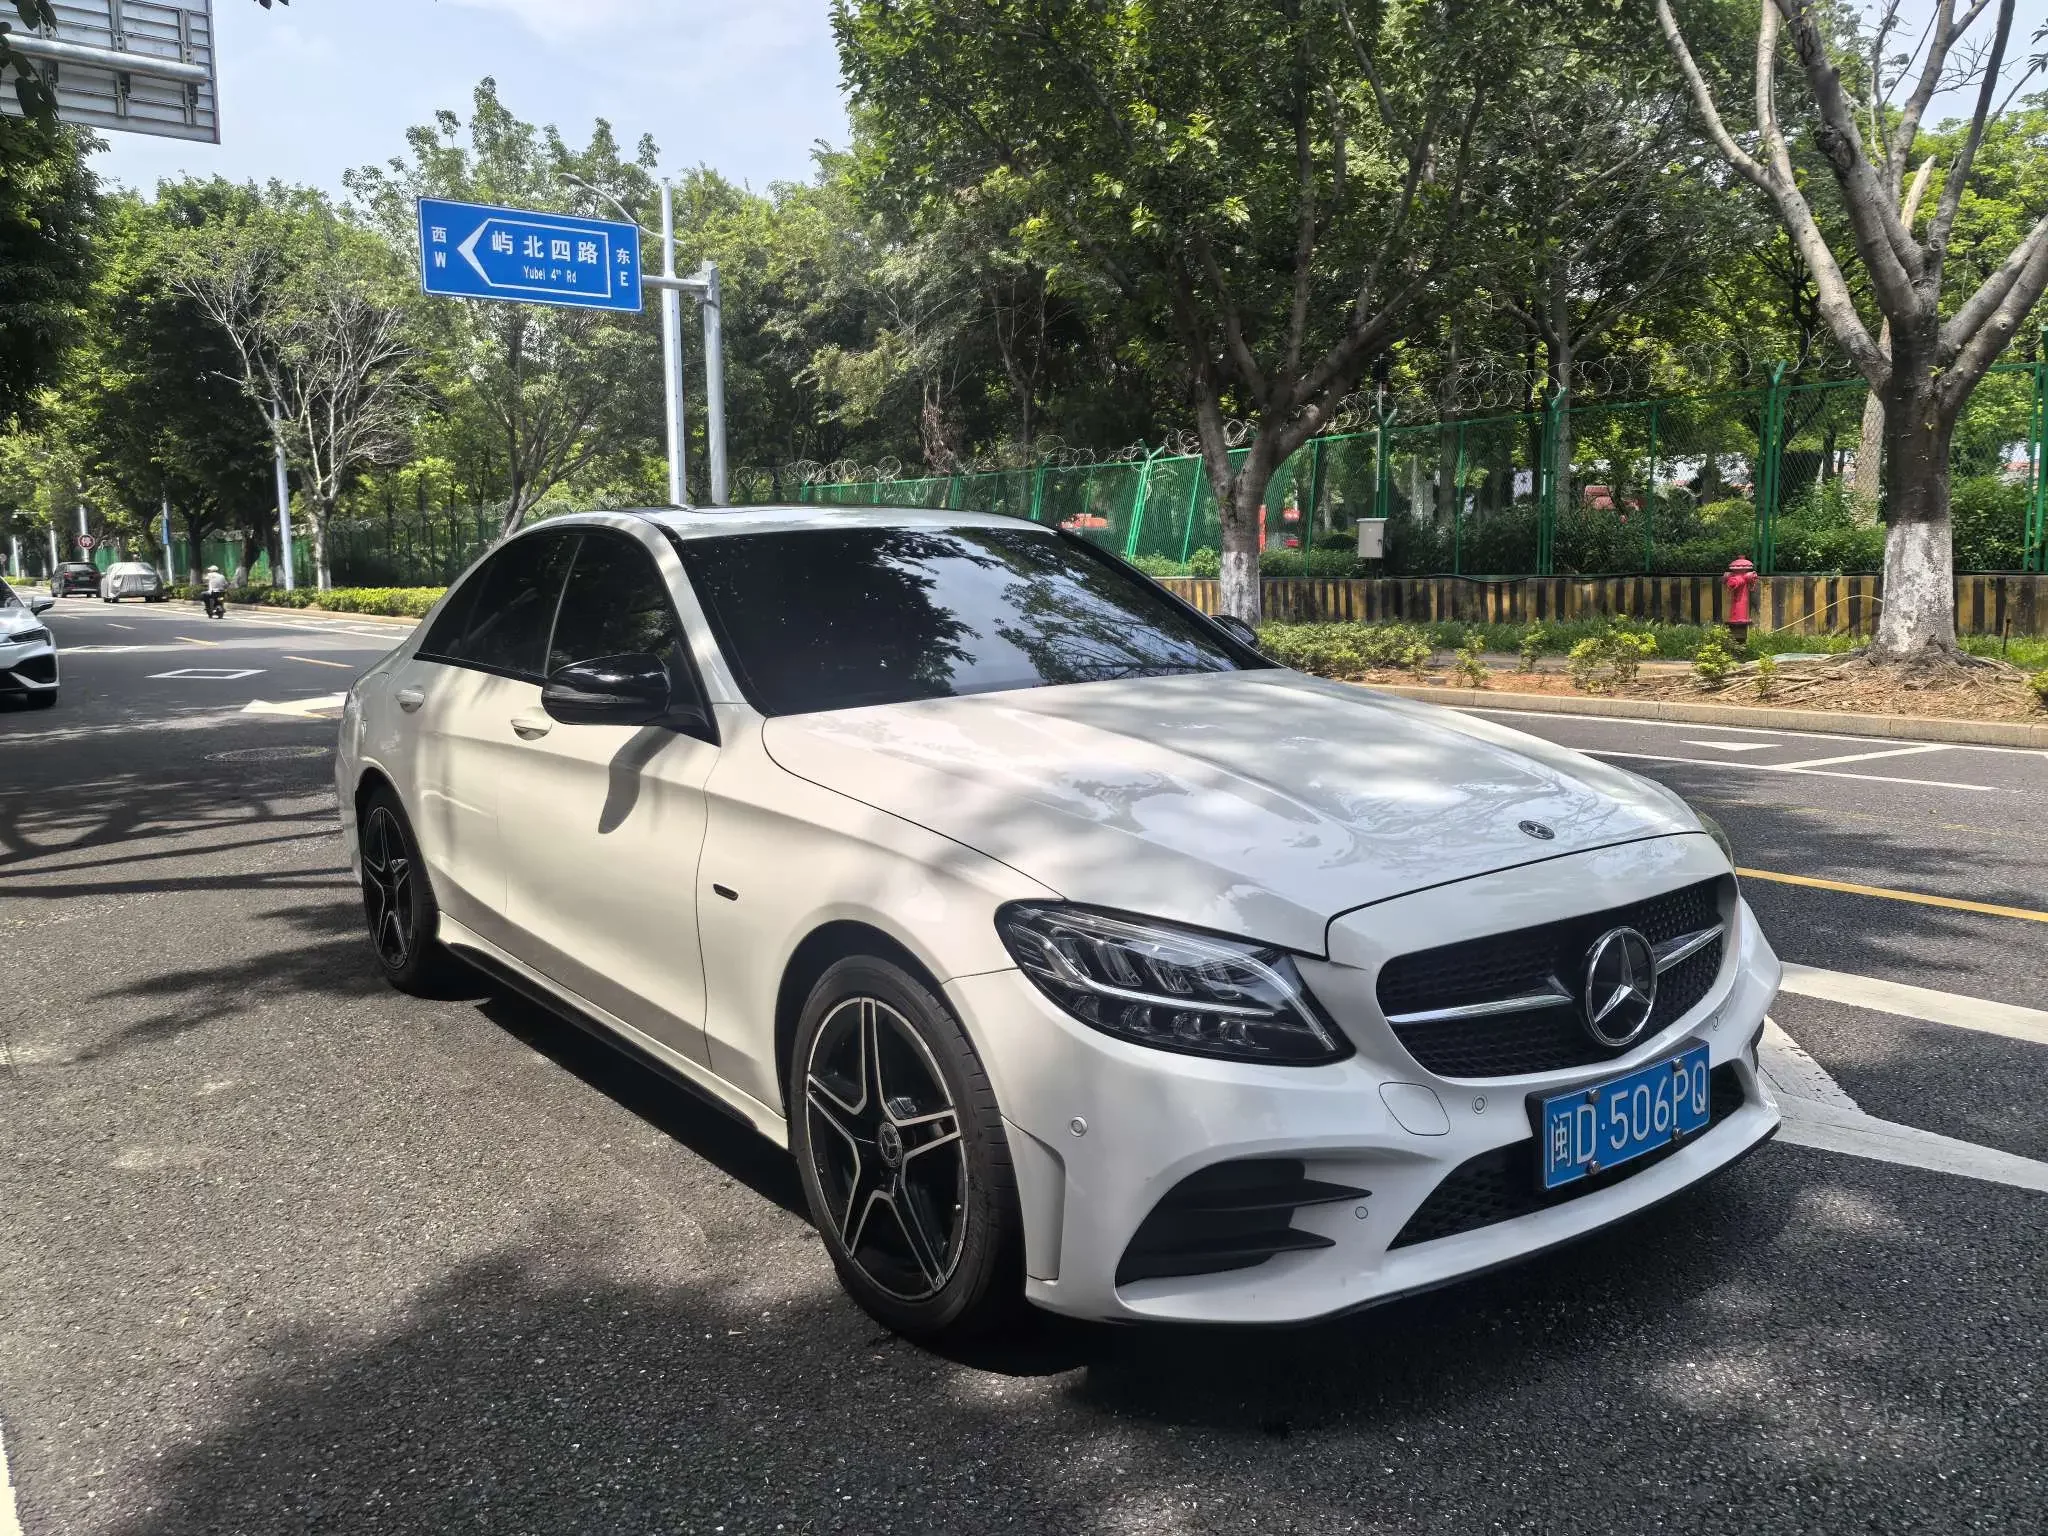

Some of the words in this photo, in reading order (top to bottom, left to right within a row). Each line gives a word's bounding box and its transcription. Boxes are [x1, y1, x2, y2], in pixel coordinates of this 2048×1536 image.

[431, 226, 447, 244] 西
[491, 230, 599, 265] 屿北四路
[615, 248, 631, 265] 东
[434, 251, 447, 269] W
[523, 265, 546, 281] Yubei
[566, 271, 577, 284] Rd
[620, 271, 629, 287] E
